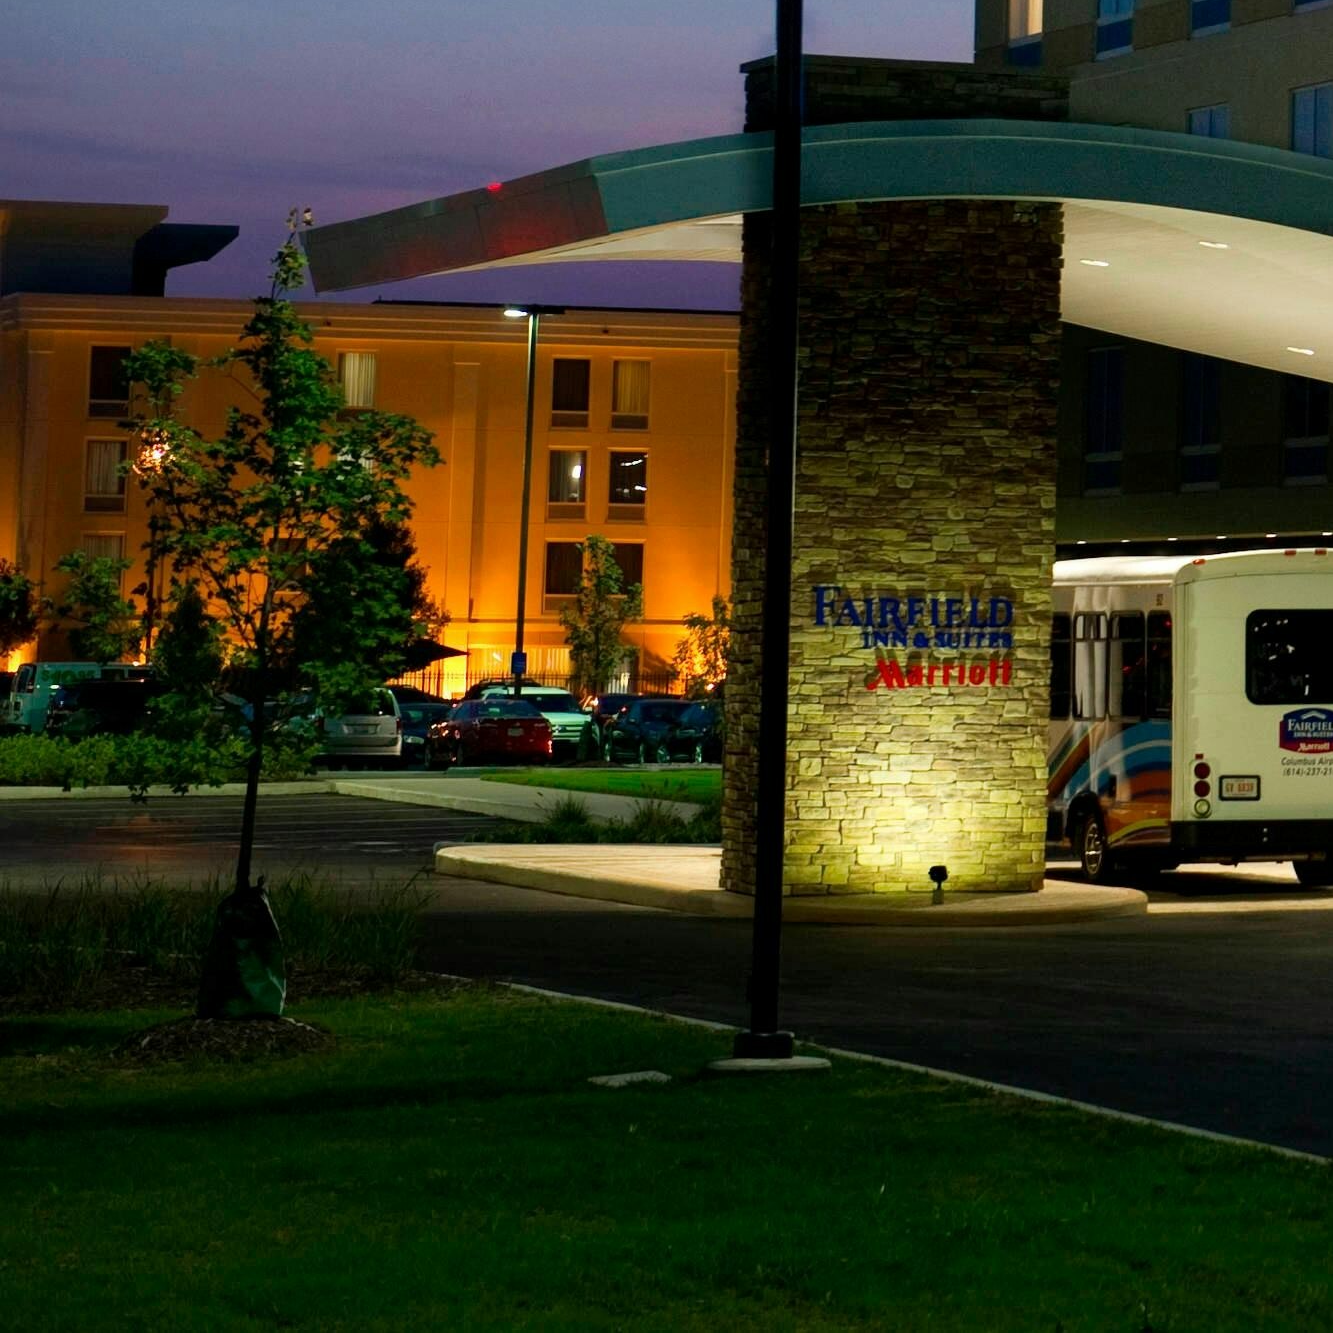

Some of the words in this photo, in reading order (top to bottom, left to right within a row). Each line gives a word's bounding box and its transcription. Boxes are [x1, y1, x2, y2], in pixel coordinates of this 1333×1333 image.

[812, 584, 1014, 630] FAIRFIELD
[933, 631, 1013, 650] SUITES
[866, 656, 1013, 691] Marriott
[1298, 741, 1331, 752] Marriott
[1281, 756, 1316, 766] Columbus
